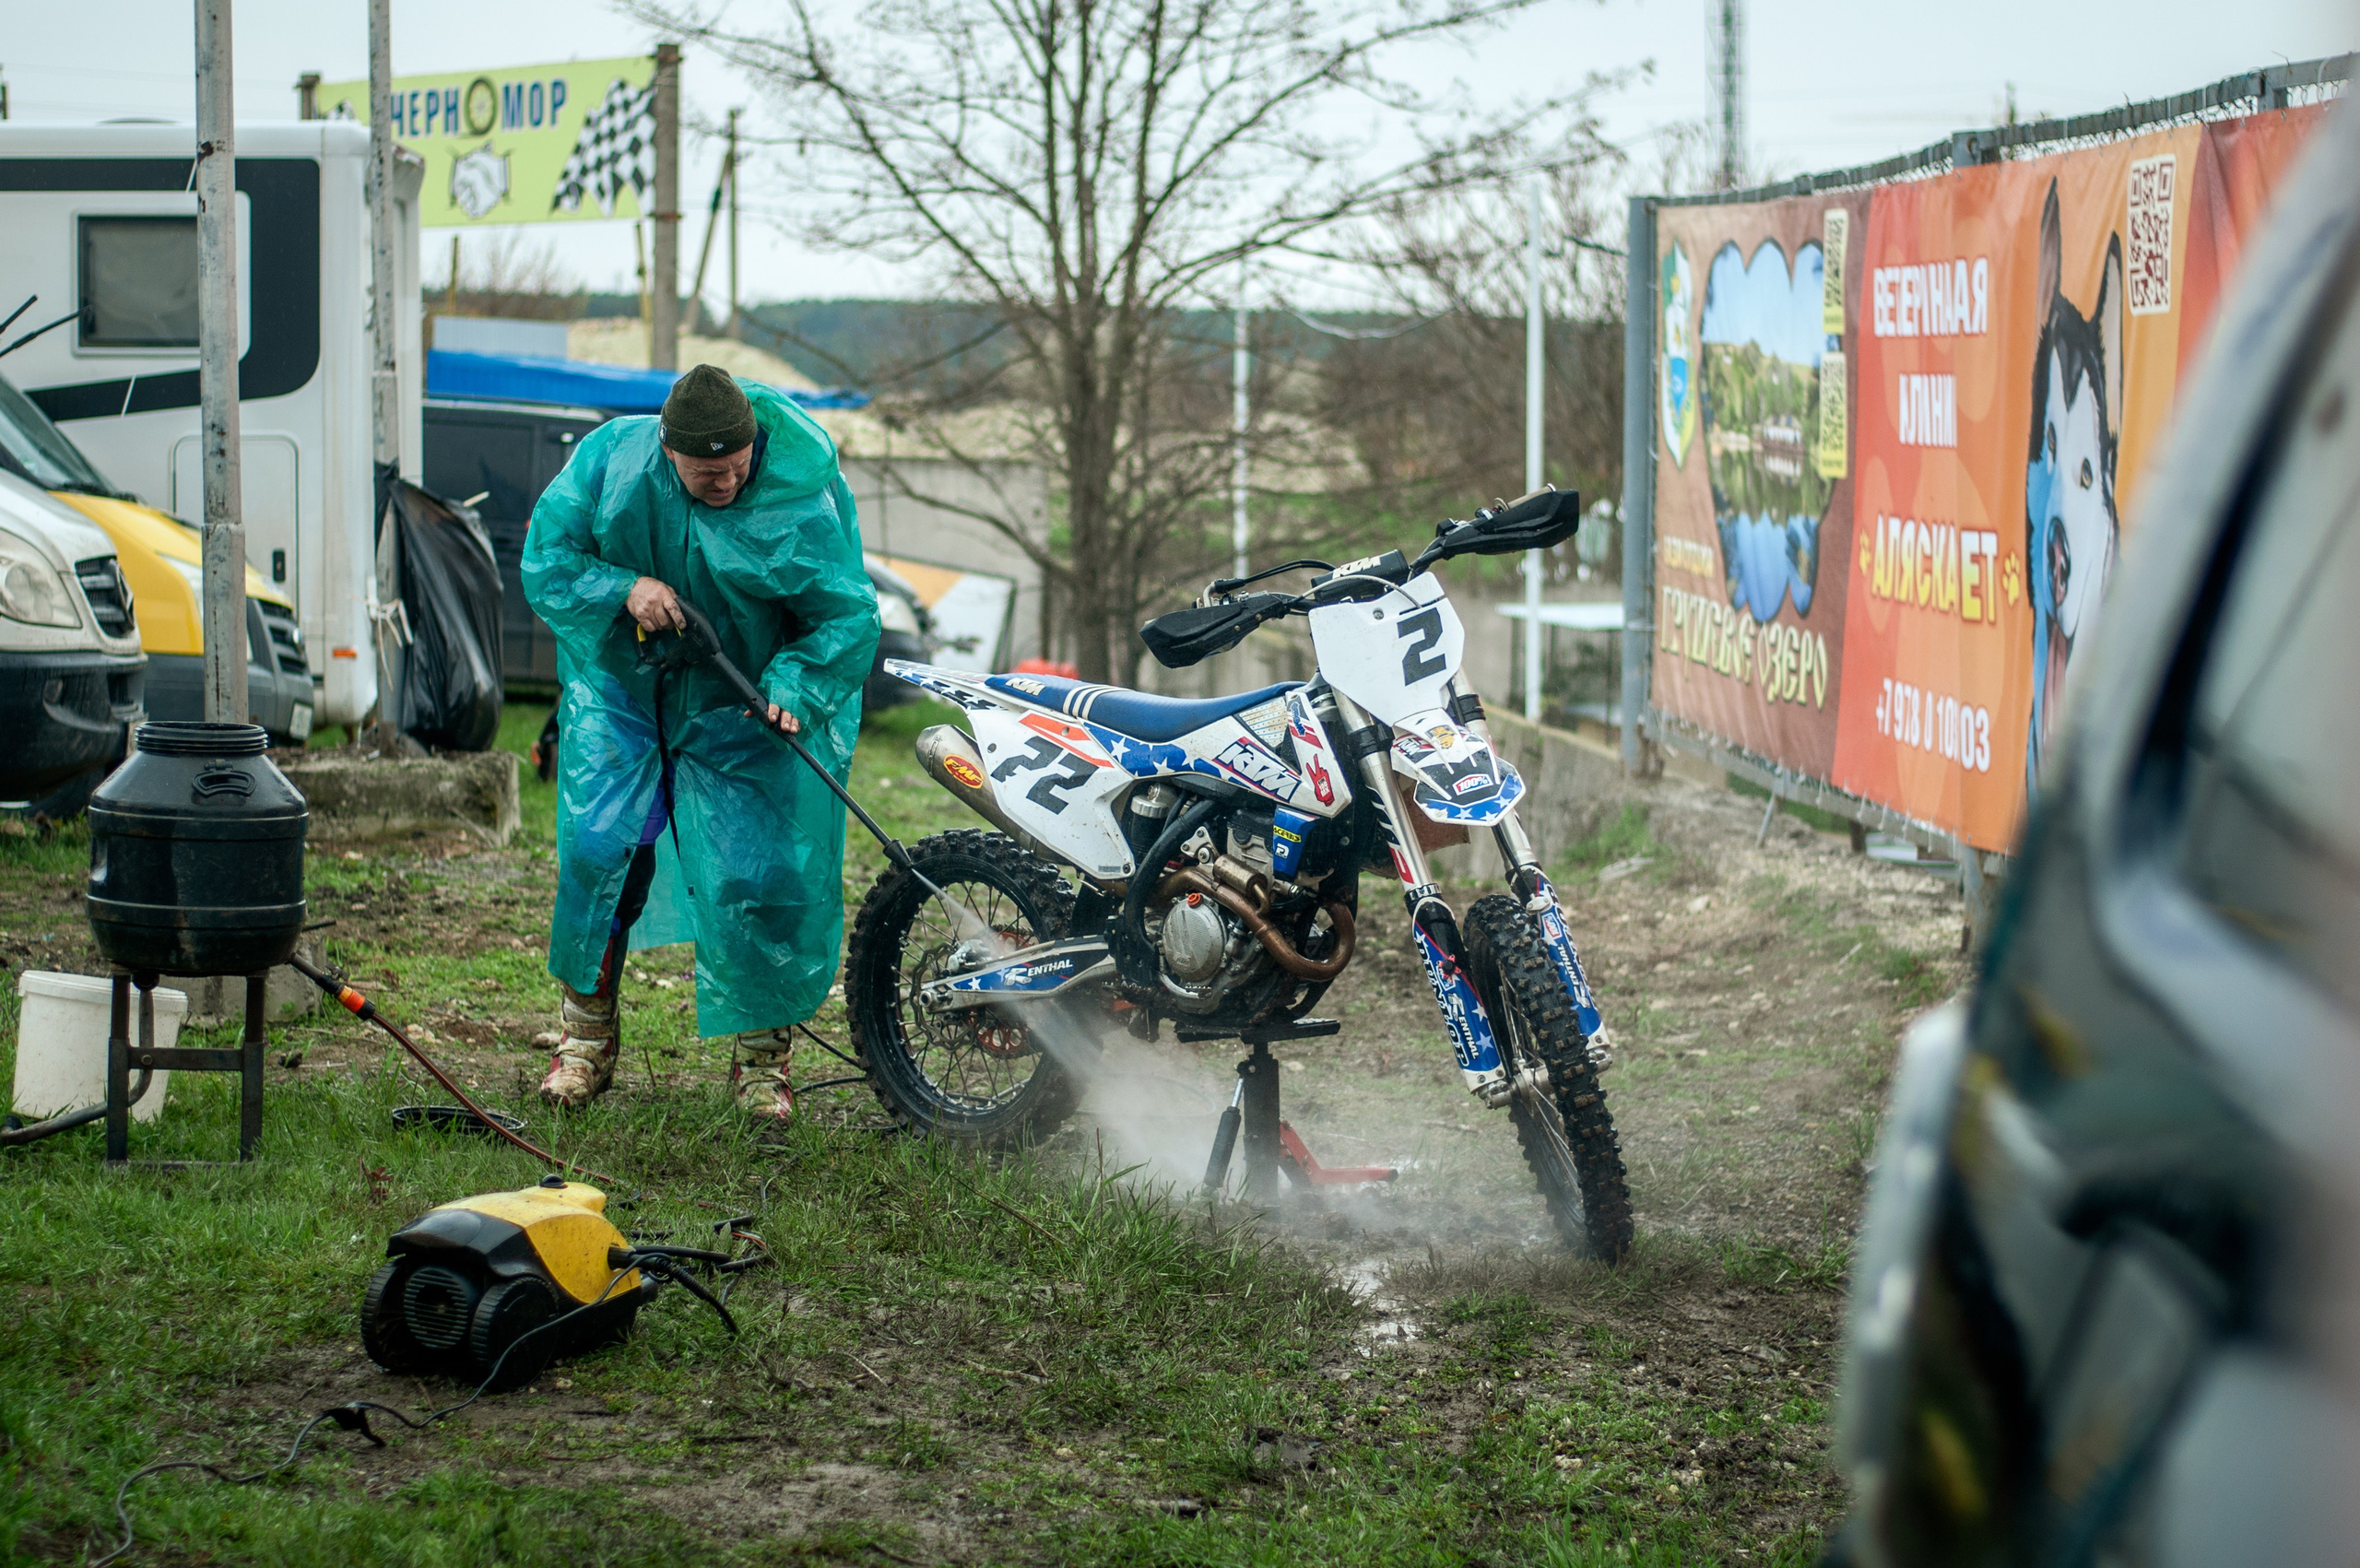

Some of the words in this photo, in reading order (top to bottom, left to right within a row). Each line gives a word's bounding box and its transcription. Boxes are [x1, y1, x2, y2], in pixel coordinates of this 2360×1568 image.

[1332, 556, 1382, 580] KTM
[1396, 607, 1447, 688] 2
[1757, 619, 1829, 713] ОЗЕРО
[1006, 678, 1046, 697] KTM
[1893, 681, 1920, 749] 978
[946, 758, 983, 784] FMF
[1216, 741, 1300, 802] KTM
[1457, 775, 1491, 792] 100%
[1273, 826, 1301, 842] ACERBIS
[1004, 959, 1074, 986] RENTHAL
[1415, 937, 1469, 1067] DUNLOP
[1556, 943, 1591, 1008] RENTHAL
[1446, 992, 1480, 1060] RENTHAL
